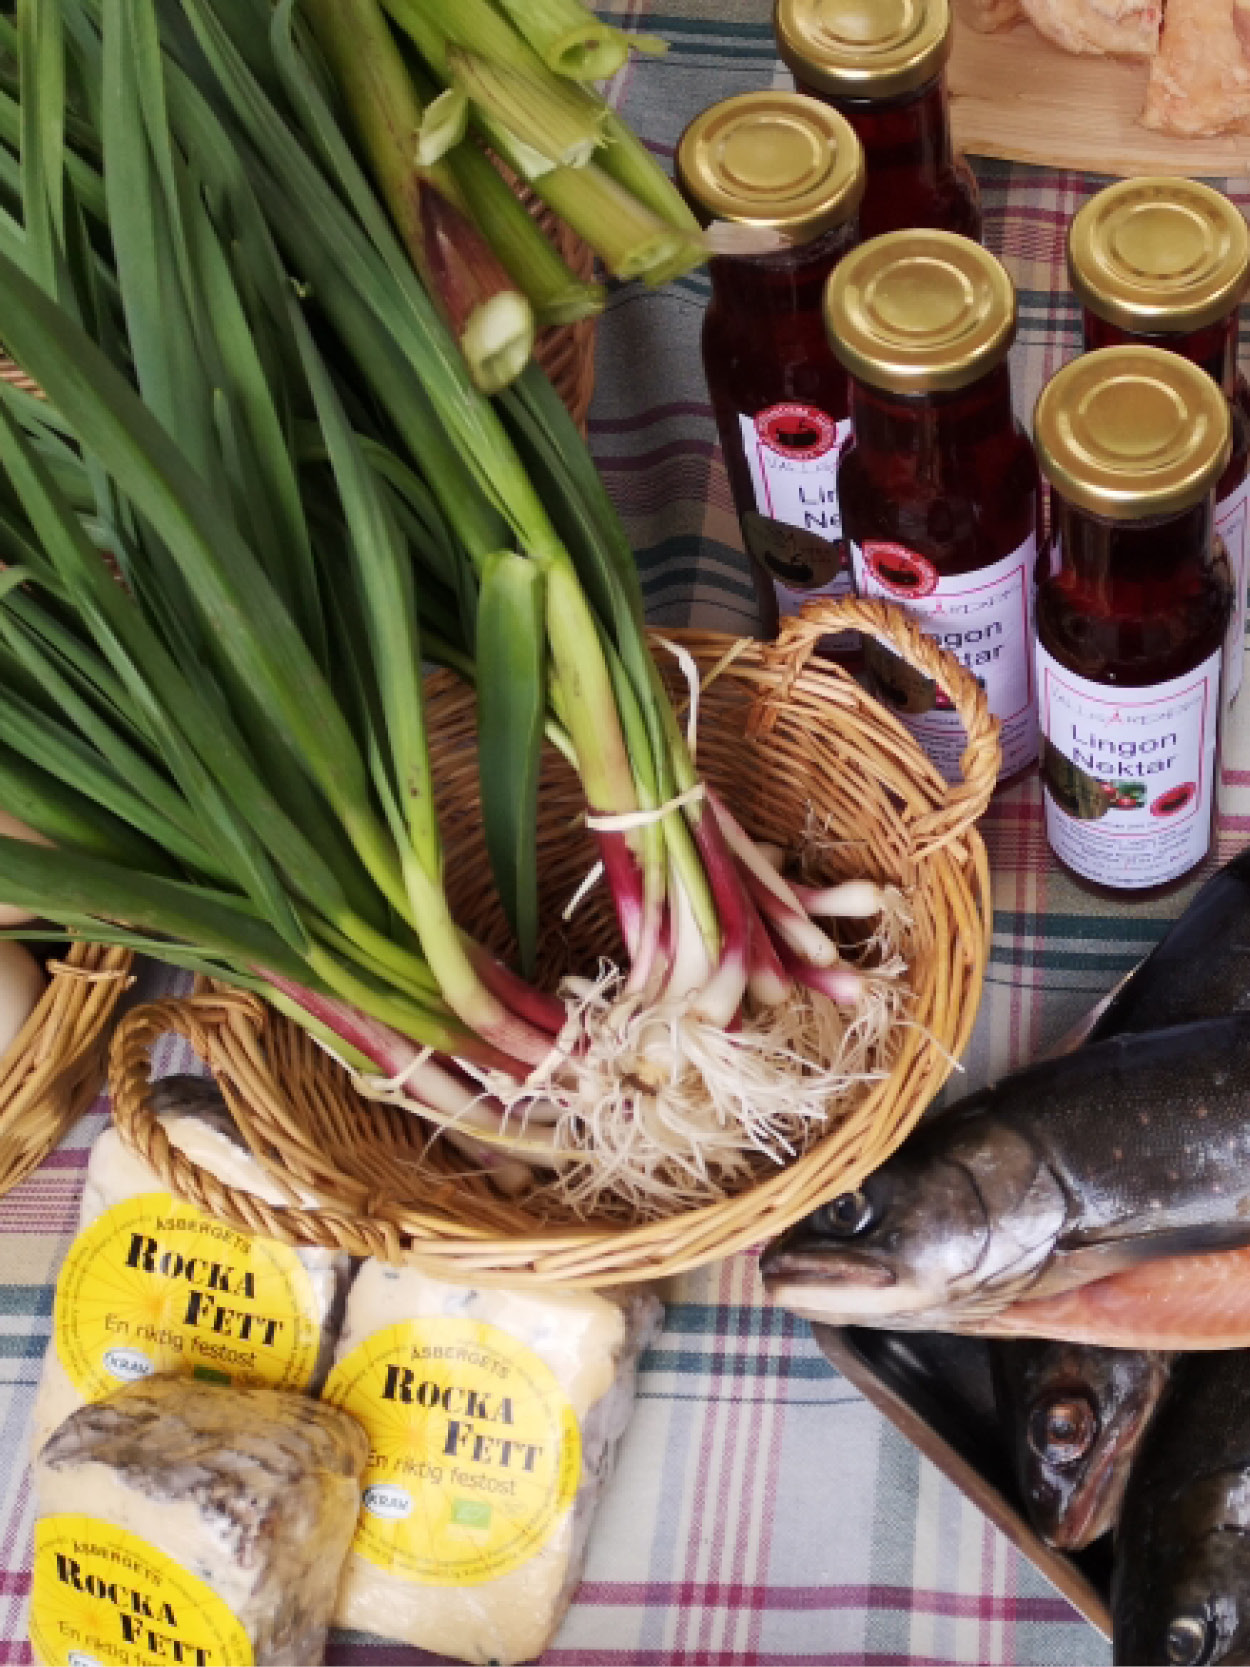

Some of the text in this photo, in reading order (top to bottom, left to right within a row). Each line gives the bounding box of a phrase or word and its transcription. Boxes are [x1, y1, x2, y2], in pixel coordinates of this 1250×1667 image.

[1072, 724, 1177, 759] Lingon
[1072, 747, 1177, 777] Nektar
[105, 1312, 257, 1369] En riktig festost
[183, 1289, 284, 1348] FETT
[442, 1420, 544, 1473] FETT
[394, 1457, 443, 1485] riktig
[450, 1467, 517, 1497] festost
